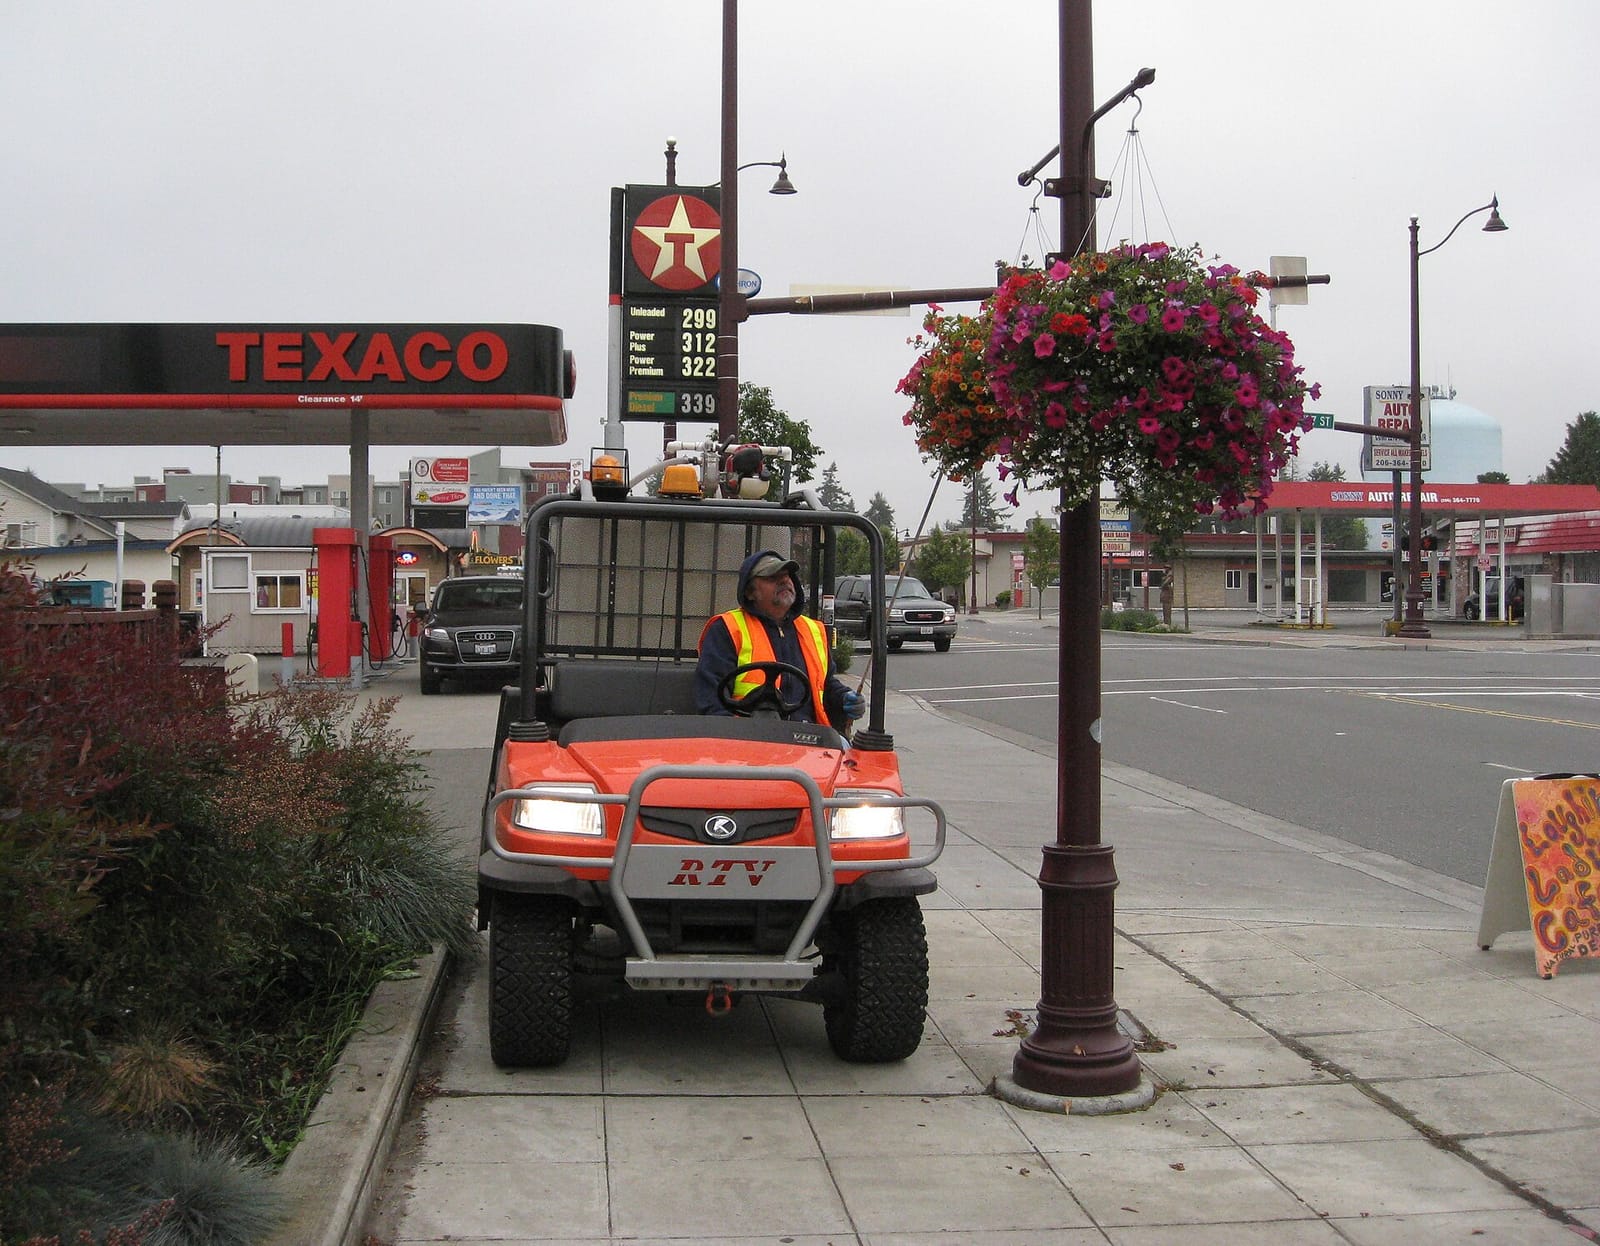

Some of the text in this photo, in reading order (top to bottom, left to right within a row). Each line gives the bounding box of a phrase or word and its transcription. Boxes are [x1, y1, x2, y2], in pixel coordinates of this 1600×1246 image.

[630, 307, 716, 329] Unleaded 299
[629, 331, 716, 353] Power 312
[629, 342, 647, 352] Plus
[215, 331, 509, 383] TEXACO
[629, 355, 716, 377] Power 322
[629, 367, 664, 376] Premium
[298, 394, 346, 403] Clearance
[1375, 390, 1403, 400] SONNY
[681, 393, 716, 414] 339
[1320, 416, 1330, 427] ST
[1377, 418, 1410, 432] REPA
[1401, 492, 1438, 502] REAIR
[475, 555, 513, 565] FLOWERS
[667, 859, 777, 887] RTV
